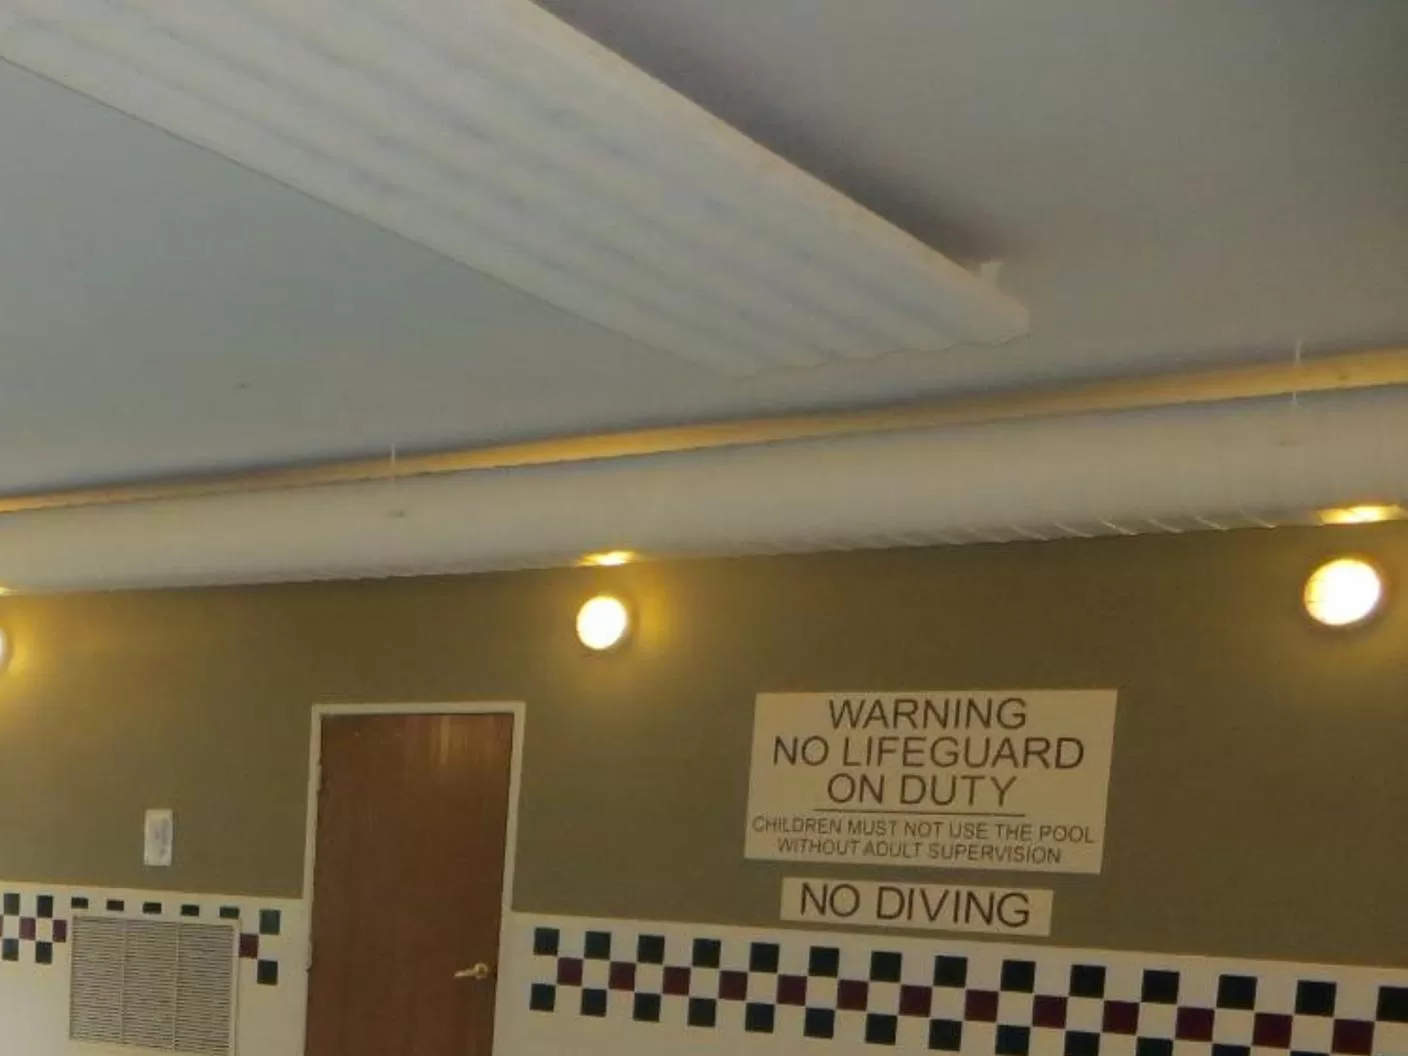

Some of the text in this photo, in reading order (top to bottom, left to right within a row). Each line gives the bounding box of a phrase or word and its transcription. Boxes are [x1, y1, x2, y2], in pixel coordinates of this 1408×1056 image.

[829, 697, 1027, 731] WARNING
[773, 735, 1084, 769] NO LIFEGUARD
[827, 773, 1018, 807] ON DUTY
[752, 815, 1096, 844] CHILDREN MUST NOT USE THE POOL
[778, 837, 1061, 864] WITHOUT ADULT SUPERVISION
[800, 882, 1030, 928] NO DIVING
